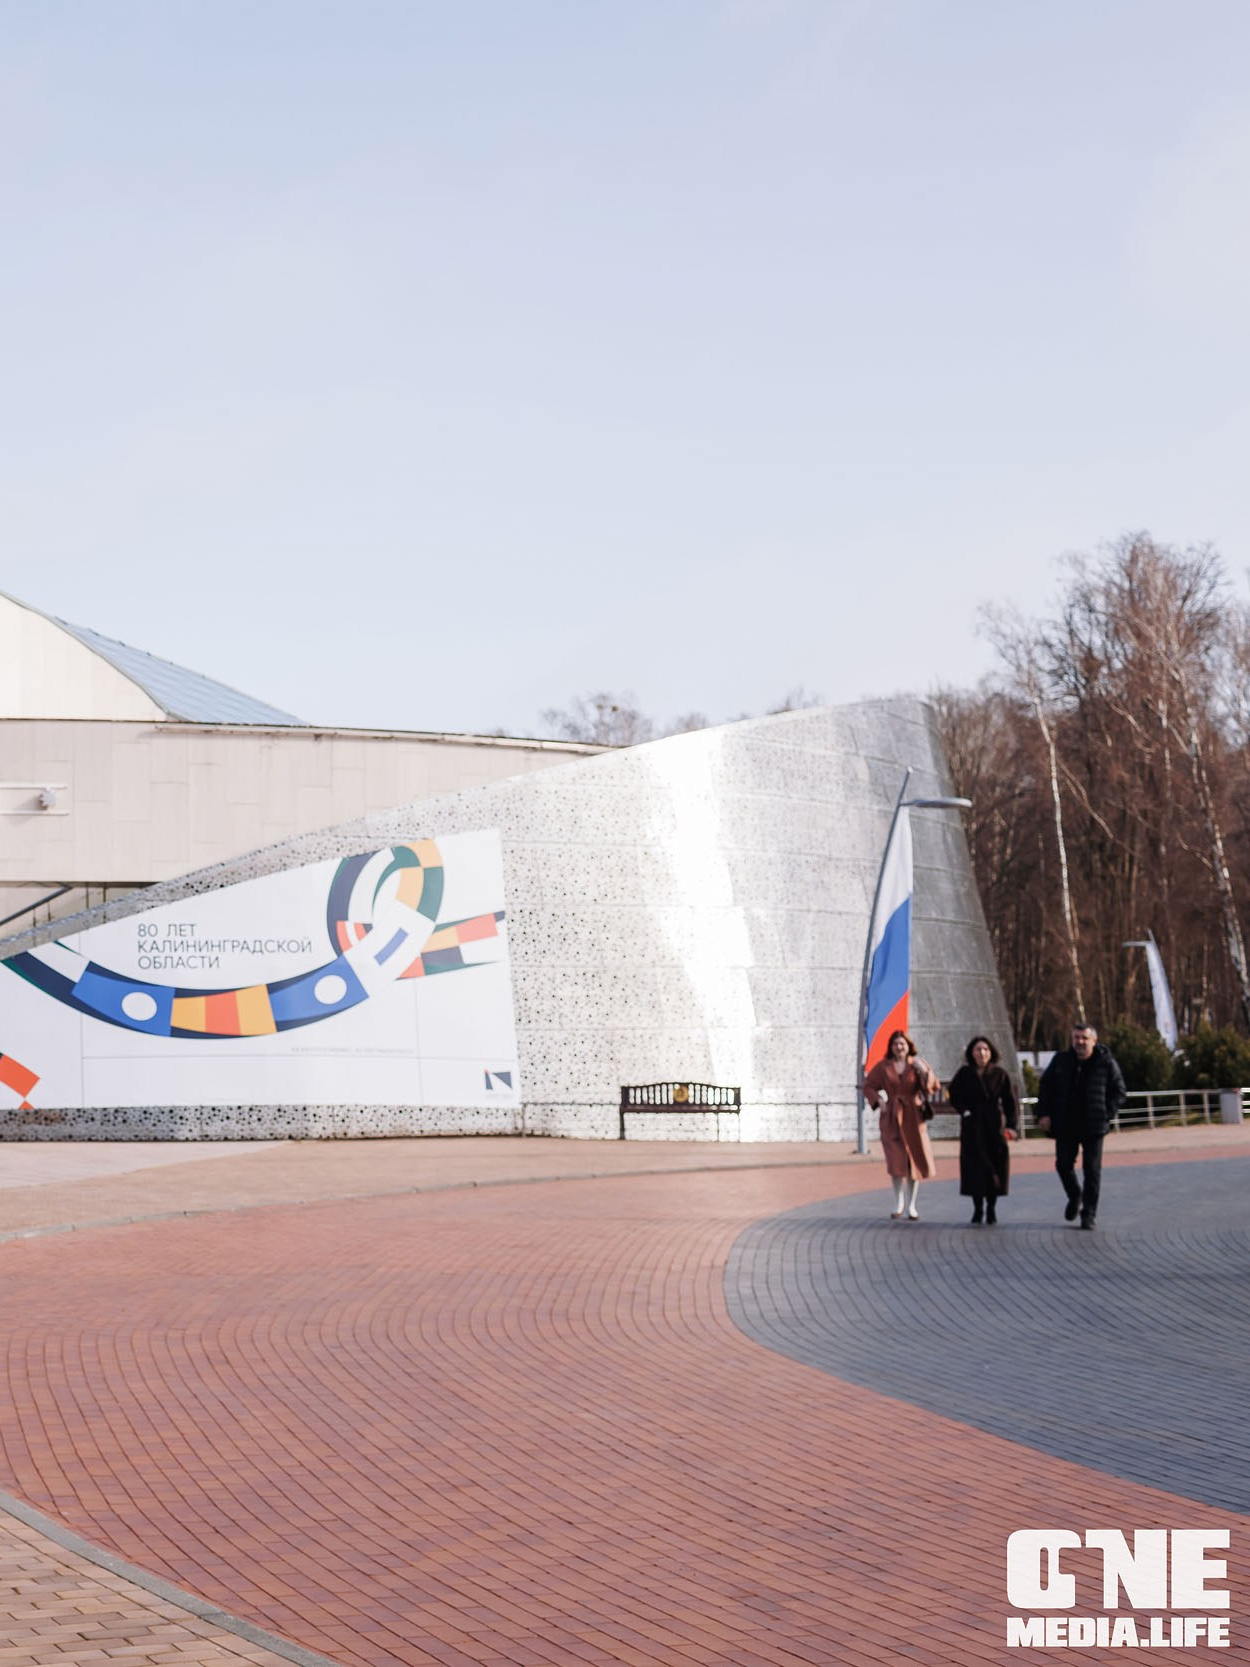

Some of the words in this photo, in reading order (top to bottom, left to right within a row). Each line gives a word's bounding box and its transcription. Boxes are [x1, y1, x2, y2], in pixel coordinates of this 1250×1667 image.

[137, 924, 158, 937] 80
[167, 924, 197, 937] ЛЕТ
[137, 937, 312, 955] КАЛИНИНГРАДСКОЙ
[137, 956, 220, 970] ОБЛАСТИ
